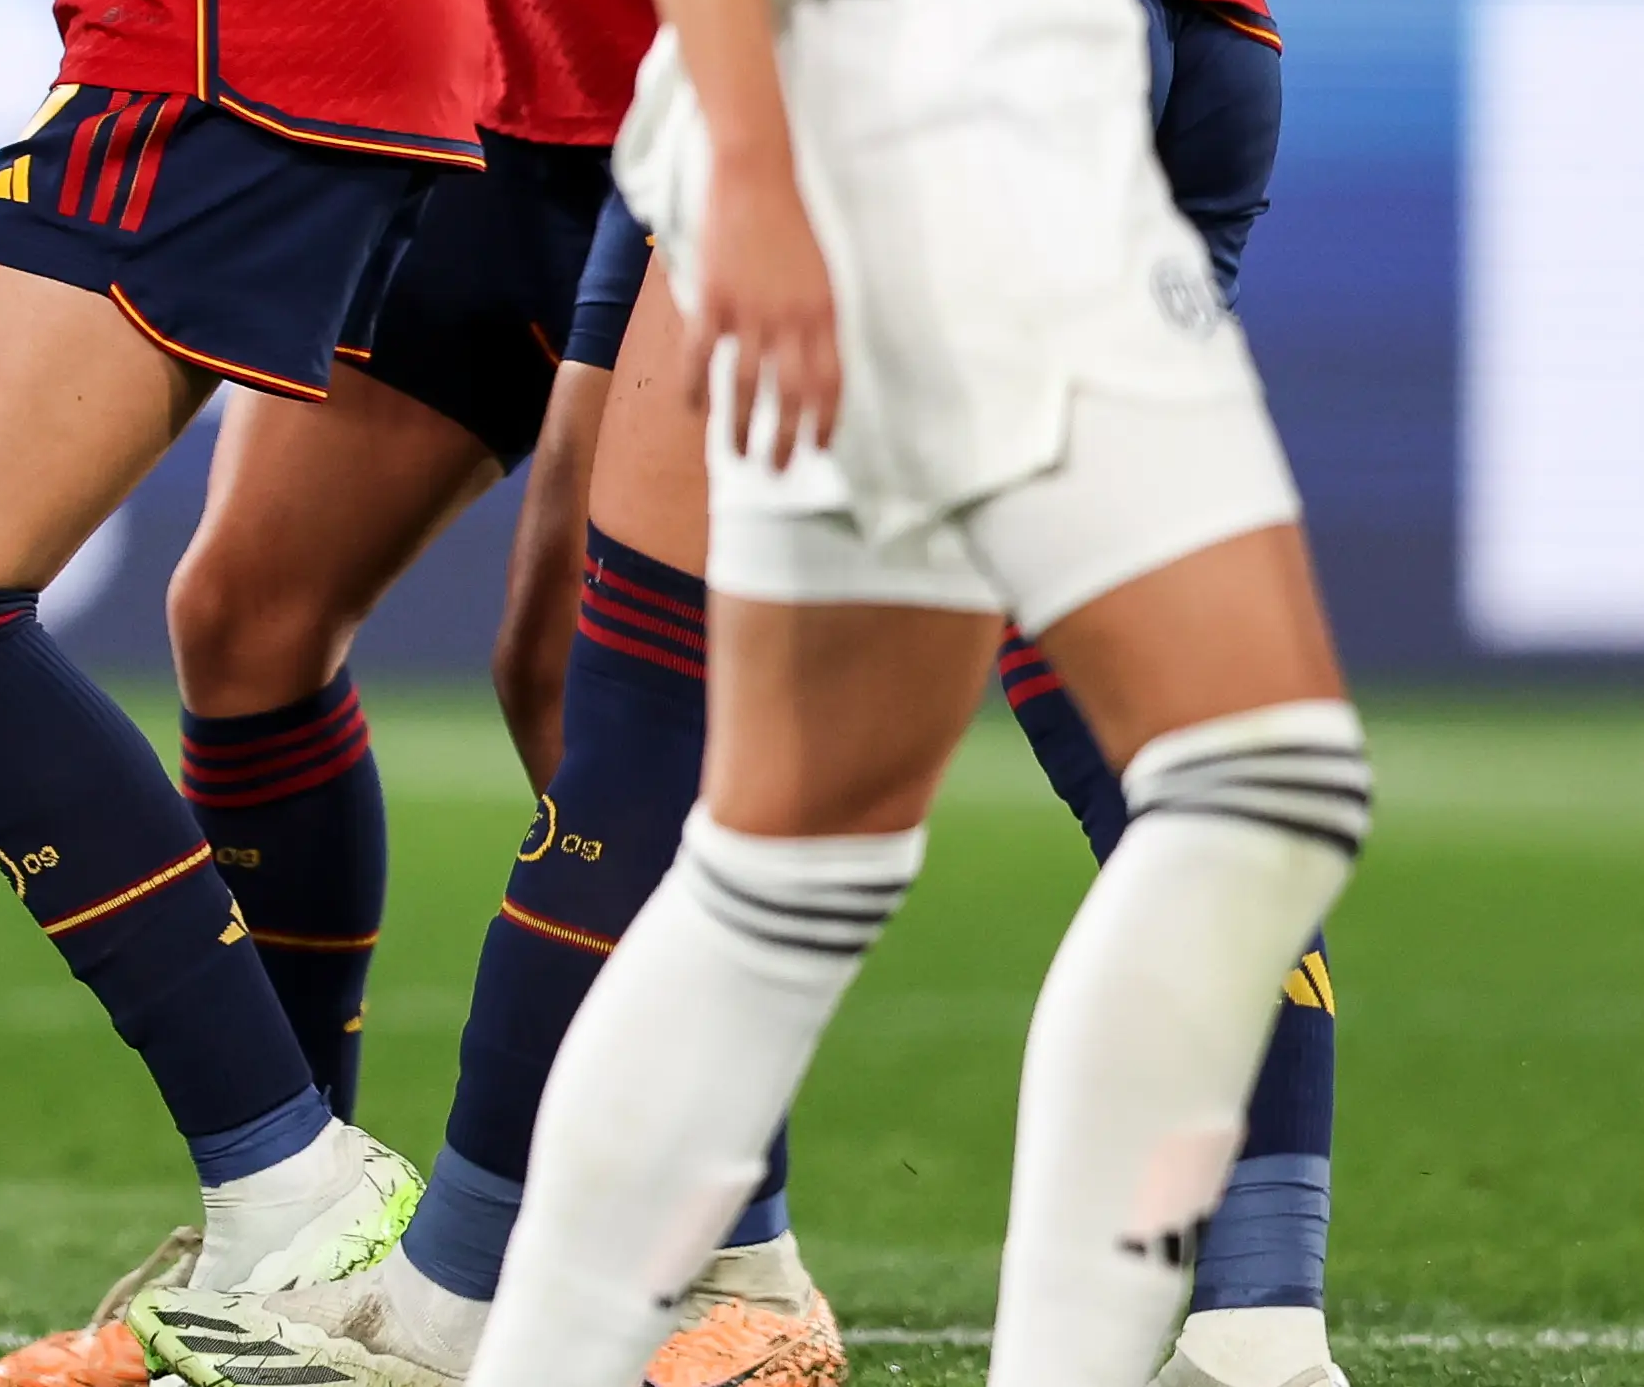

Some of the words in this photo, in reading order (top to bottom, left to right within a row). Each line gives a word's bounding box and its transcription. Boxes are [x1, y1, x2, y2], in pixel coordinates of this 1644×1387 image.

[22, 845, 60, 874] 09
[216, 847, 260, 869] 09
[561, 834, 603, 861] 09
